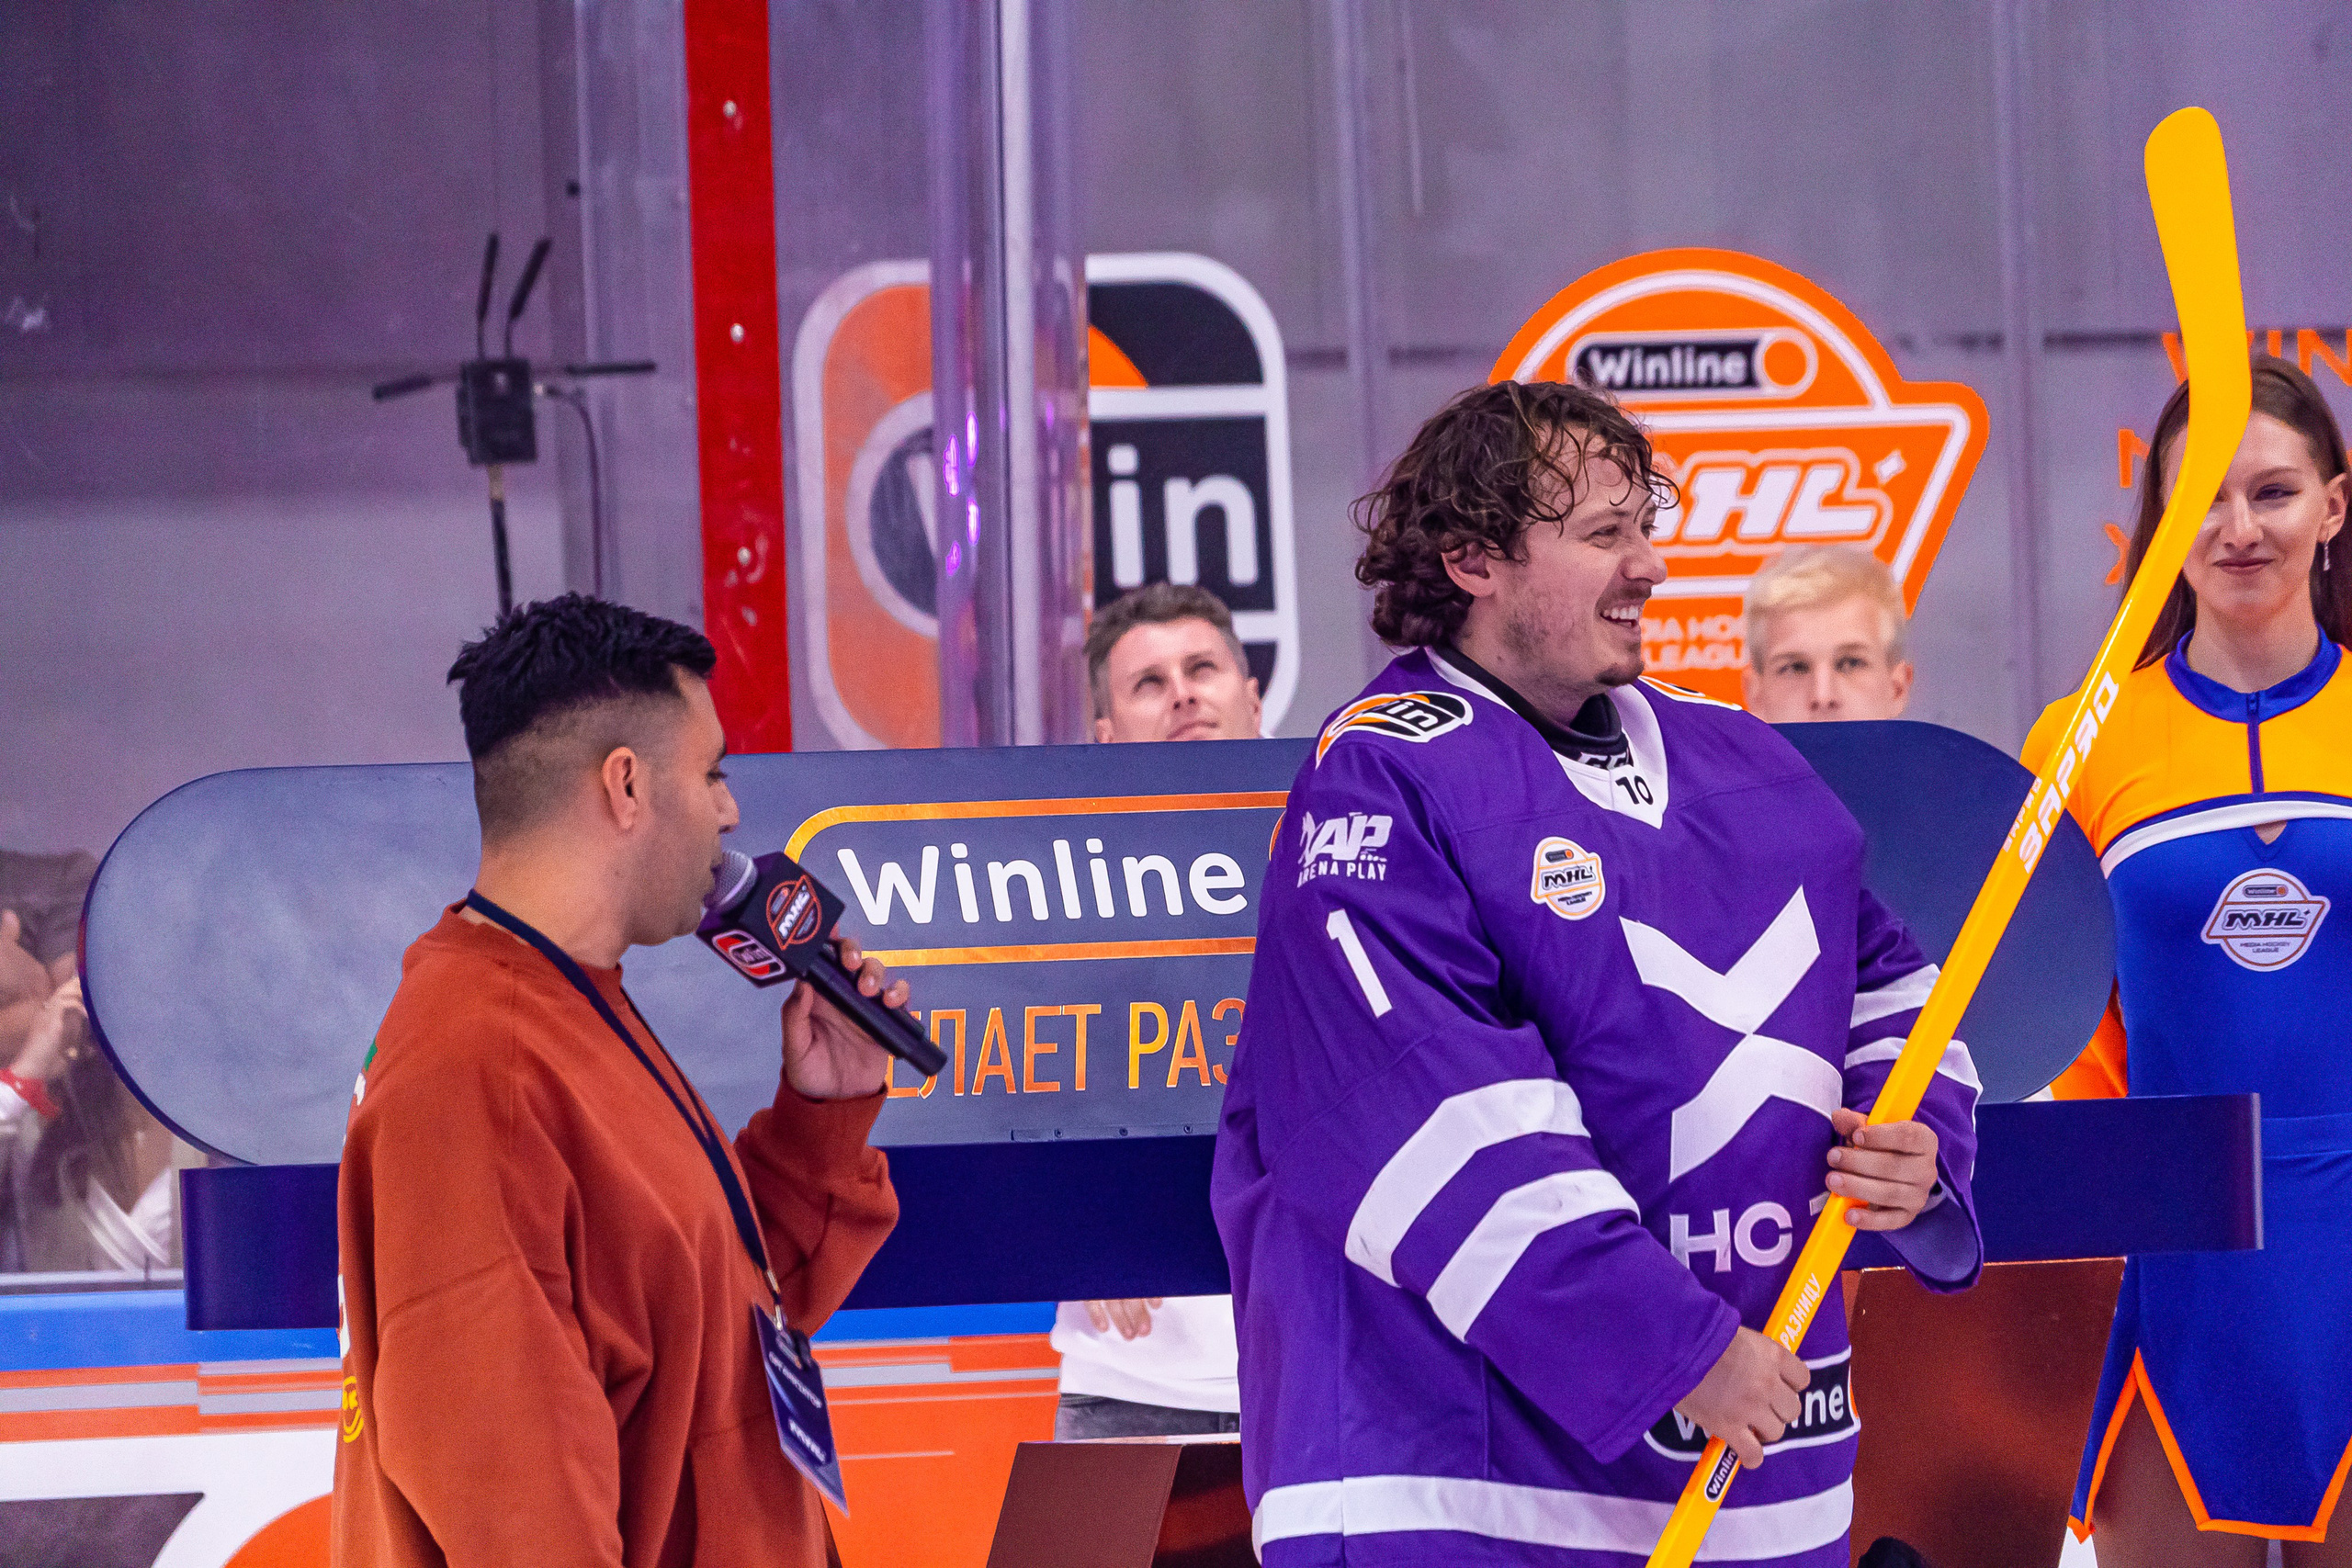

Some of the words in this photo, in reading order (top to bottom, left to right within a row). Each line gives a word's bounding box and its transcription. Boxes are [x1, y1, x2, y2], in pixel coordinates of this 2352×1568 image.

[1589, 341, 1747, 387] Winline
[1614, 774, 1654, 805] 10
[837, 838, 1248, 925] Winline
[1346, 862, 1386, 881] PLAY
[1544, 869, 1593, 888] MHL
[2225, 911, 2304, 928] MHL
[1326, 908, 1393, 1018] 1
[1707, 1449, 1737, 1495] Winlin
